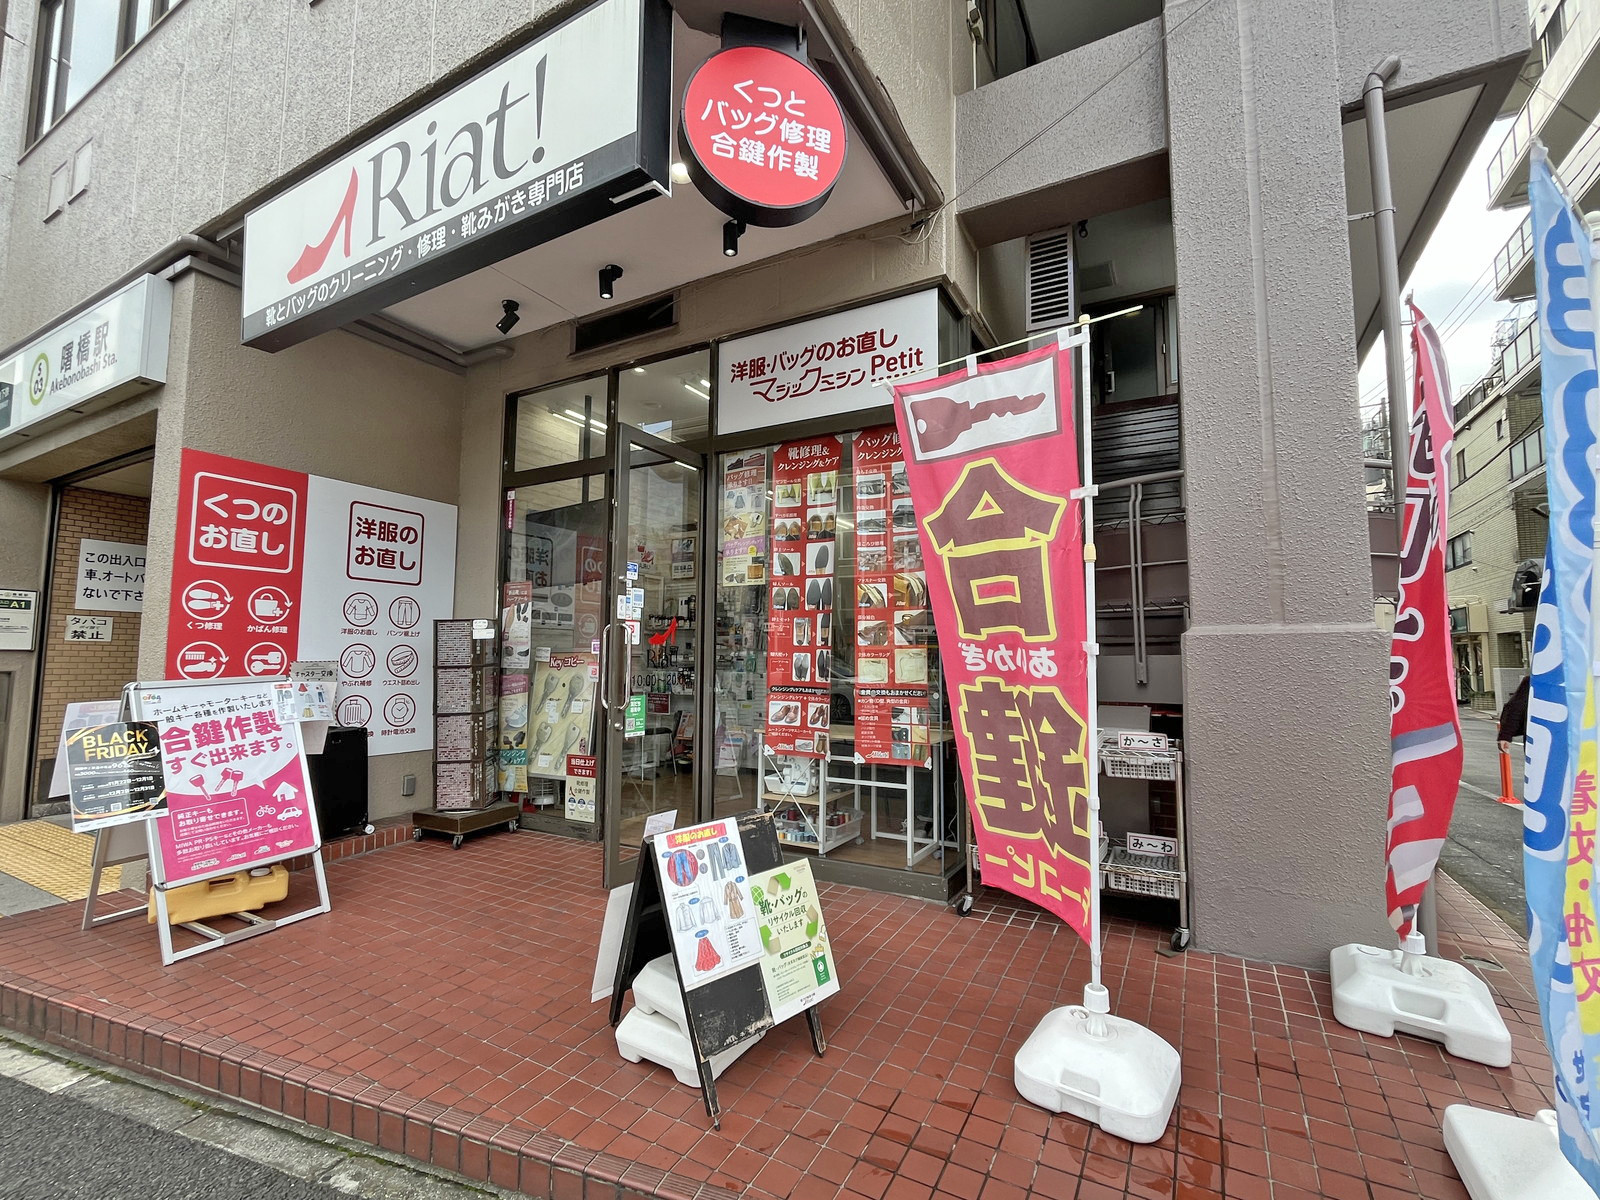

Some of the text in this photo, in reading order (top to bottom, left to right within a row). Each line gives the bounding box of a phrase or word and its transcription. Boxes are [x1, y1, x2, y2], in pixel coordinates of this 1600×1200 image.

[733, 79, 806, 117] くつと
[701, 99, 832, 154] バッグ修理
[366, 54, 548, 246] Riat!
[710, 132, 819, 180] 合鍵作製
[265, 162, 584, 327] 靴とバッグのクリーニング・修理・靴みがき専門店
[60, 321, 109, 373] 曙橋駅
[730, 328, 898, 383] 洋服・バッグのお直し
[38, 363, 42, 376] S
[50, 351, 117, 395] Akebonobashi Sta.
[871, 348, 923, 375] Petit
[34, 377, 43, 395] 03
[750, 366, 866, 402] マジックミシン
[788, 444, 830, 460] 靴修理&
[204, 494, 288, 525] くつの
[200, 524, 284, 555] お直し
[355, 517, 418, 545] 洋服の
[85, 552, 146, 568] この出入口
[355, 545, 416, 571] お直し
[71, 617, 107, 626] タバコ
[71, 630, 104, 640] 禁止
[187, 621, 223, 630] くつ修理
[247, 625, 288, 634] かばん修理
[341, 628, 377, 636] 洋服のお直し
[550, 656, 563, 670] Key
[83, 729, 148, 749] BLACK
[160, 709, 282, 755] 合鍵作製
[84, 742, 149, 762] FRIDAY
[165, 736, 293, 775] すぐ出来ます。
[759, 887, 808, 916] 靴・バッグの
[768, 905, 807, 926] リサイクル回収
[777, 919, 803, 935] いたします
